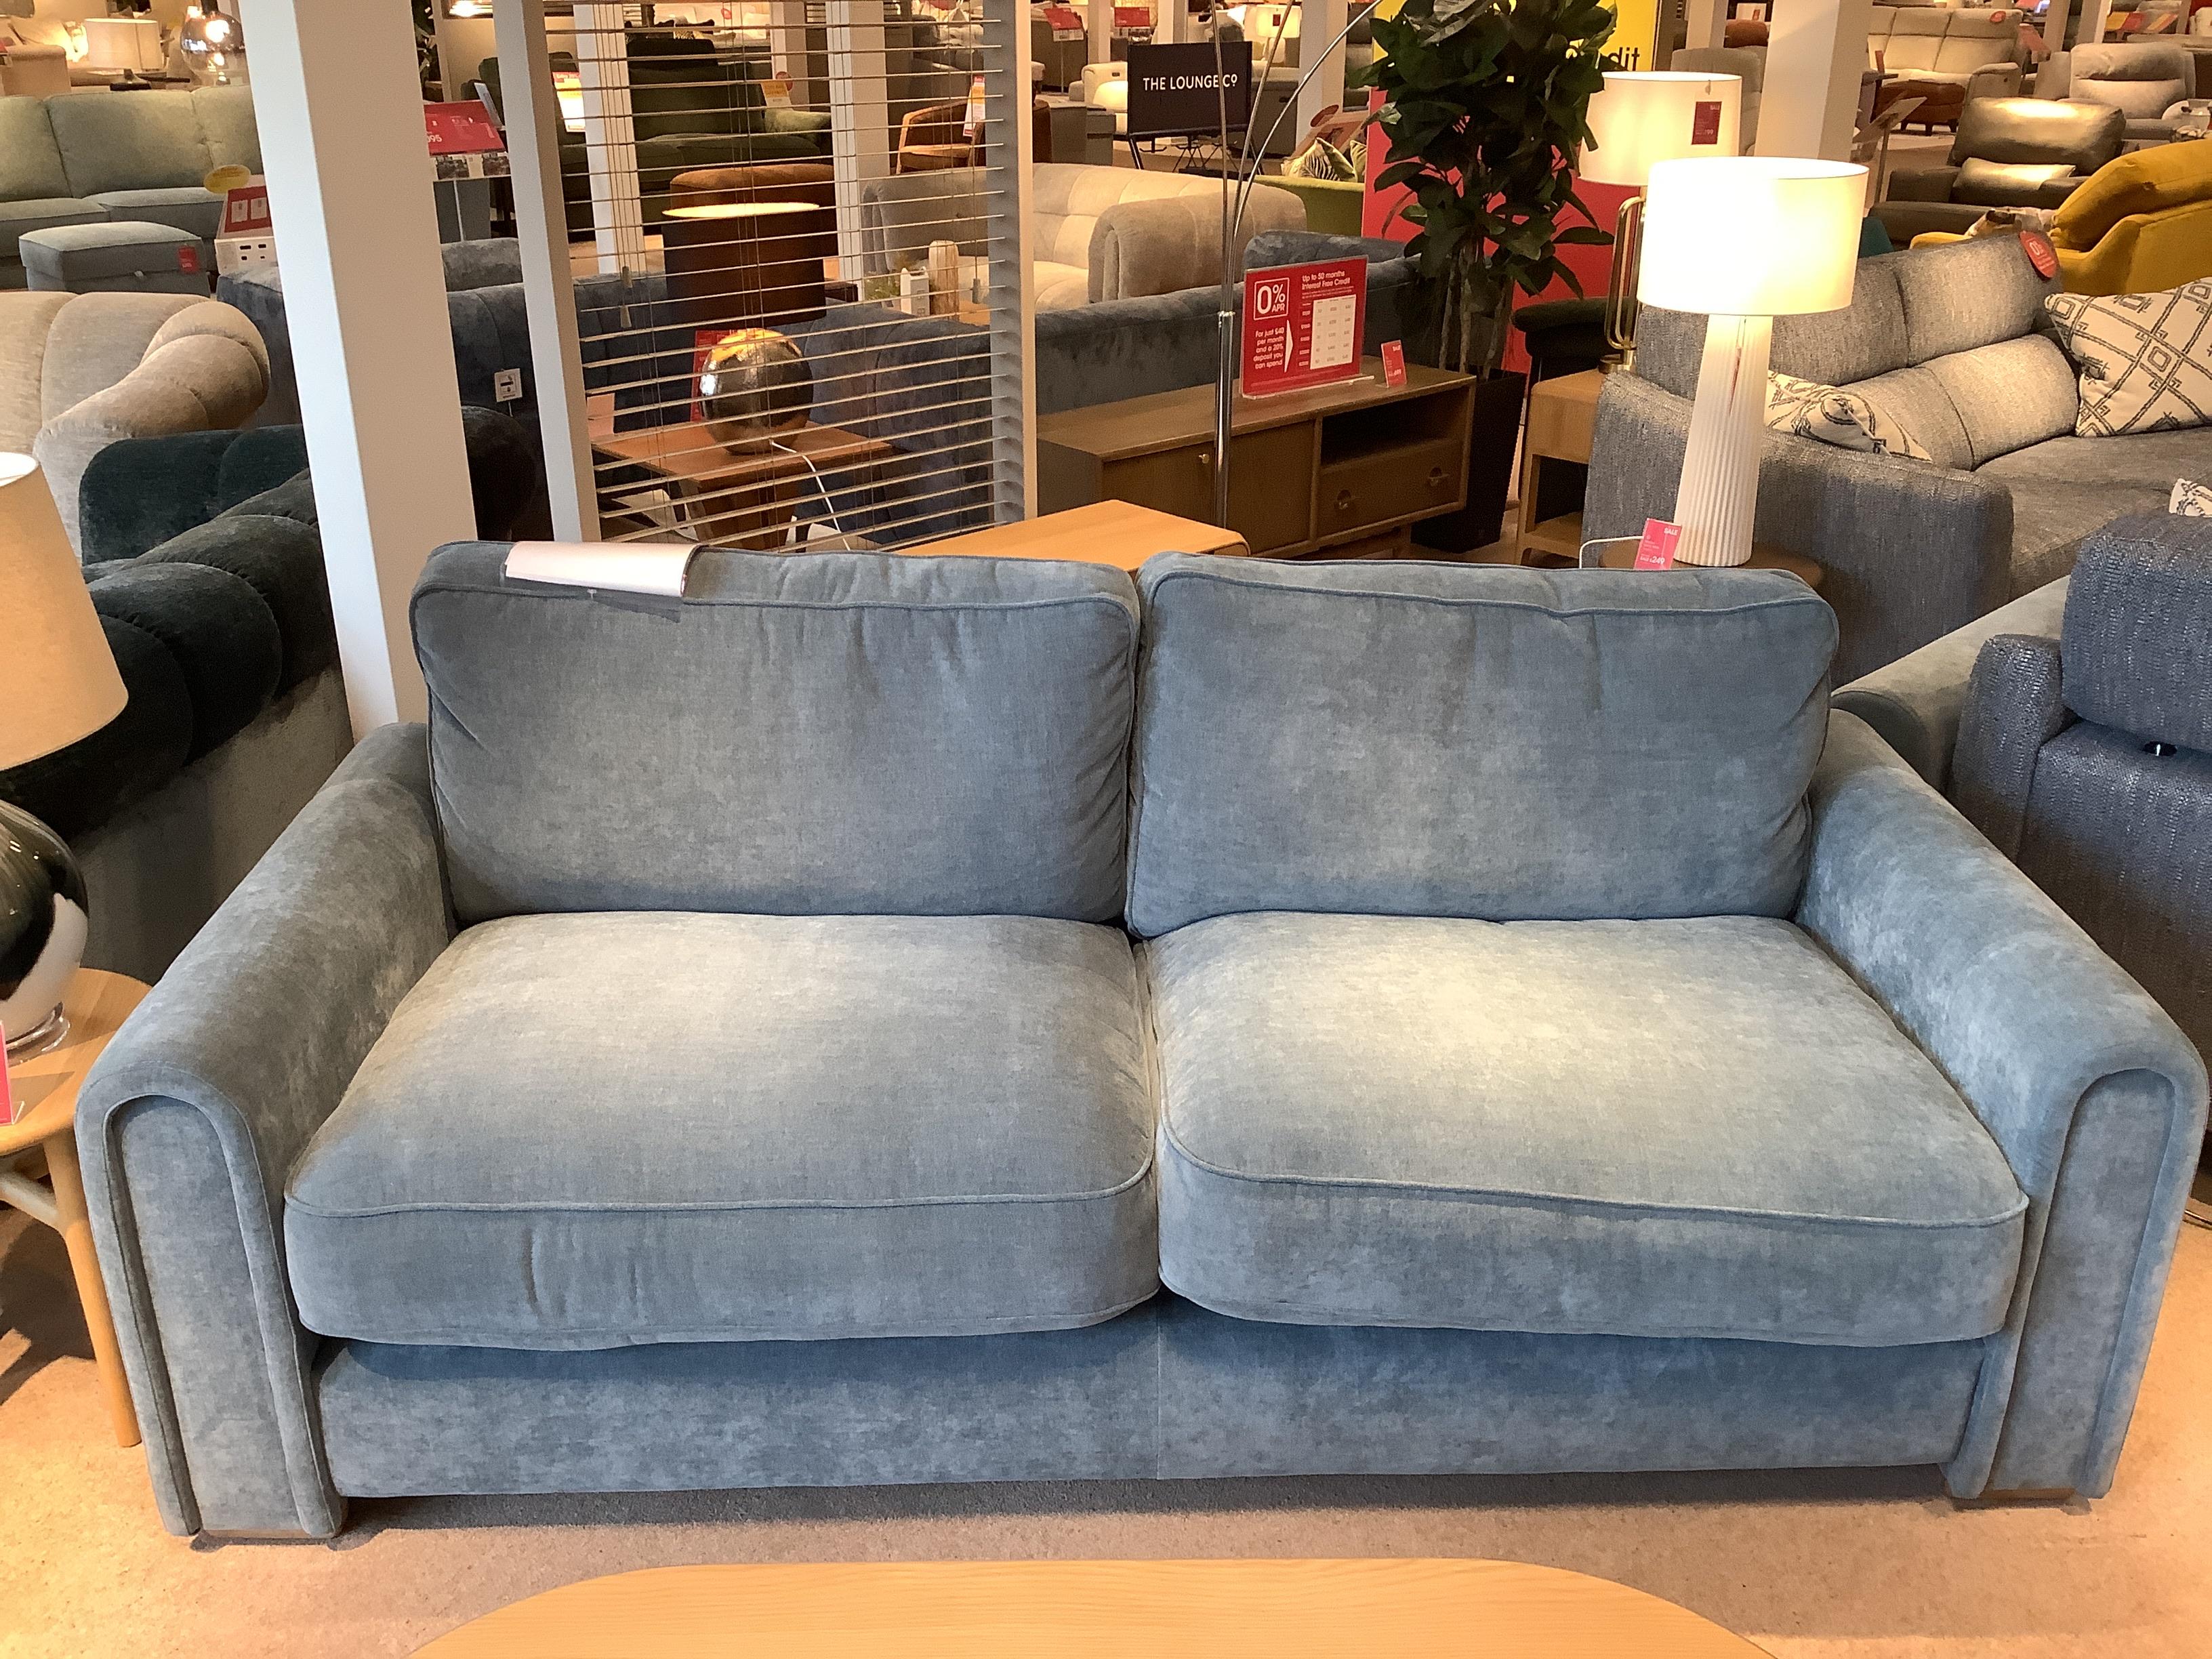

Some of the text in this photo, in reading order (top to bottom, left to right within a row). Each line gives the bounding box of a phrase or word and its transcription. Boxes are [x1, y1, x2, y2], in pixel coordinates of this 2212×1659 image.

[1143, 77, 1166, 91] THE
[1170, 75, 1219, 90] LOUNGE
[1326, 270, 1345, 279] months
[1302, 281, 1322, 290] Interest
[1334, 277, 1351, 285] Credit
[1257, 283, 1286, 314] 0%
[1271, 303, 1286, 313] APR
[1253, 352, 1273, 362] deposit
[1267, 359, 1283, 368] spend
[1664, 527, 1679, 536] SALE
